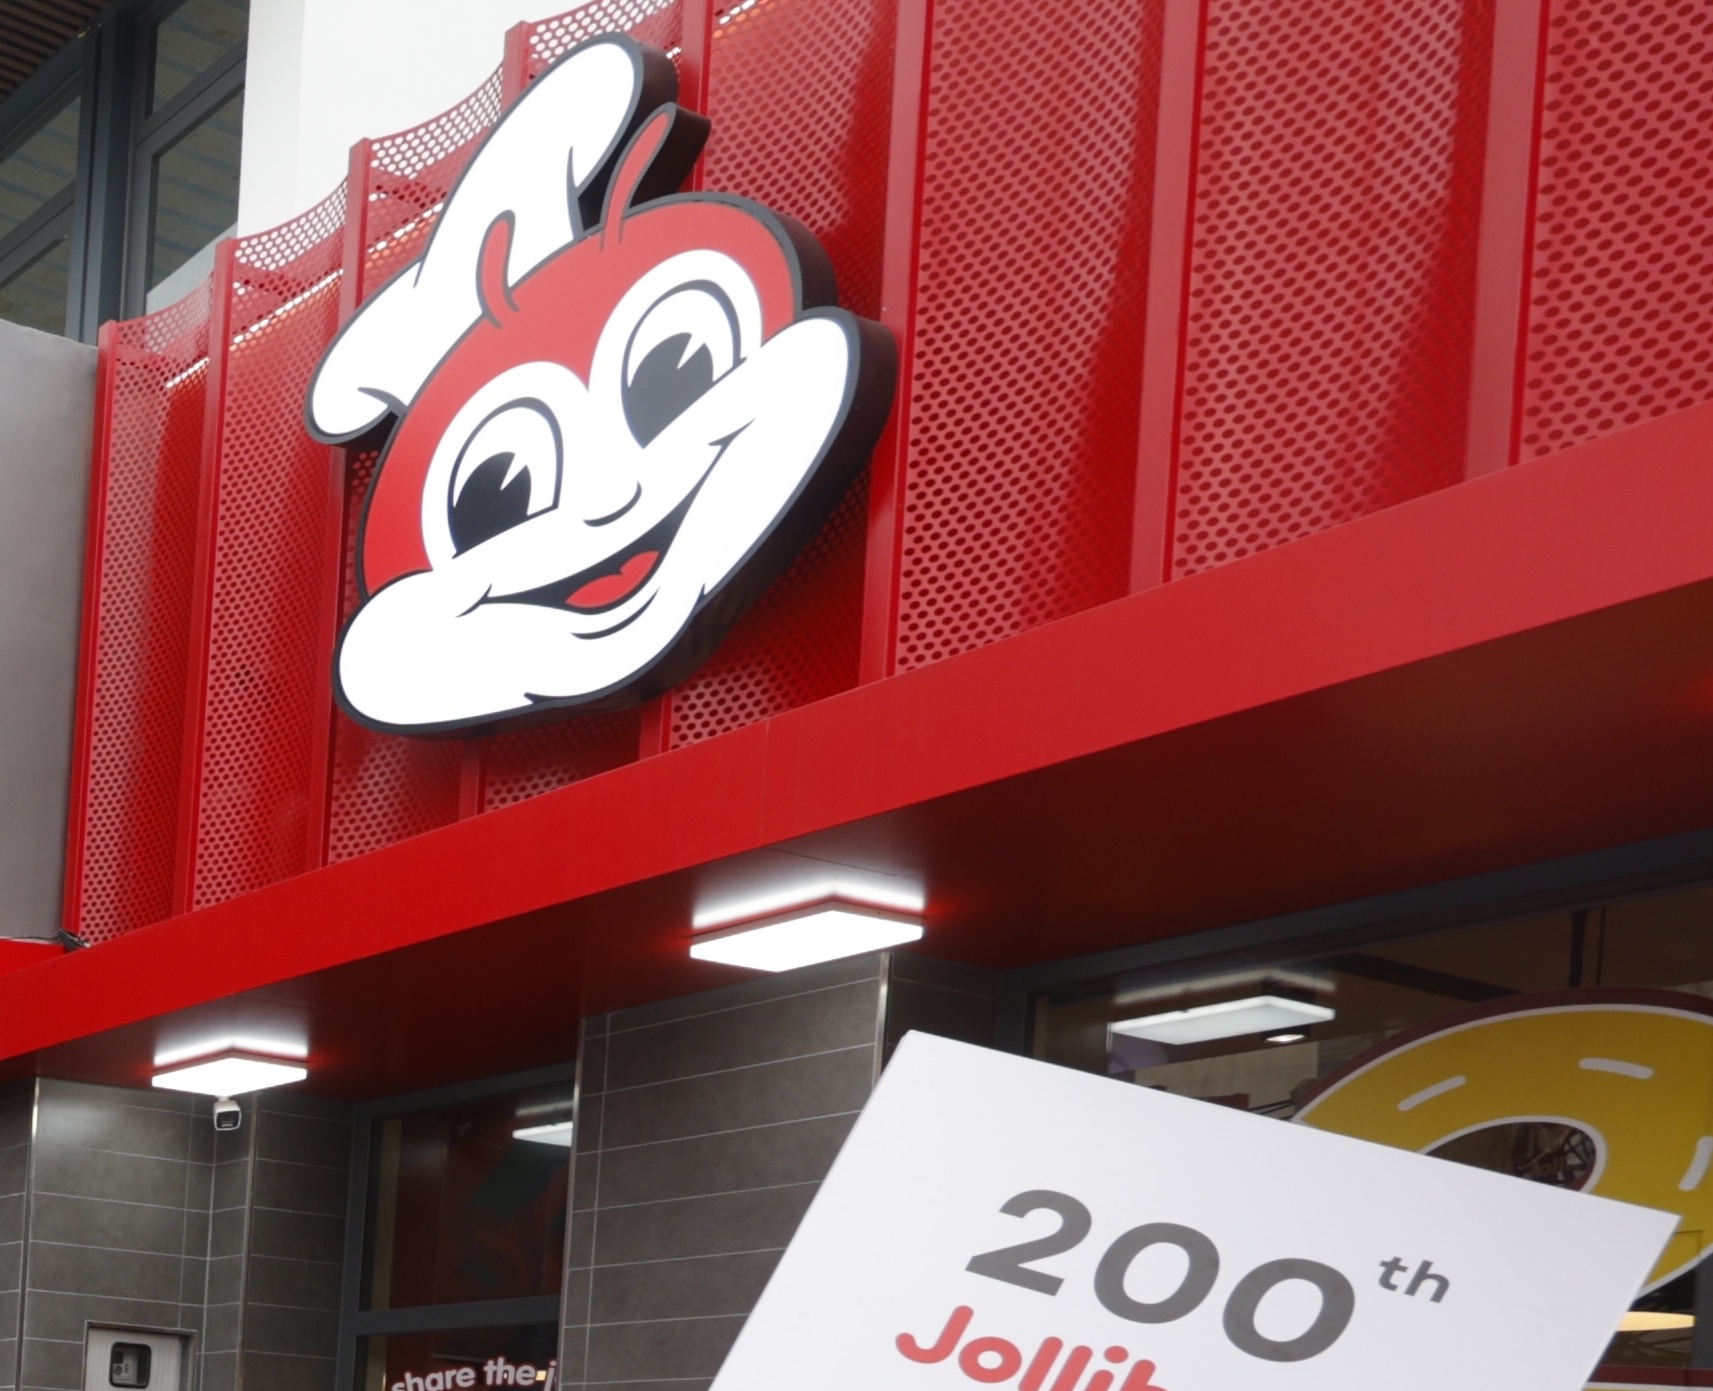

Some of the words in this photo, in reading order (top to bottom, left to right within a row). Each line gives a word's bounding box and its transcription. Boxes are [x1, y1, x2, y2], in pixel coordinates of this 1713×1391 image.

[965, 1189, 1355, 1361] 200
[1377, 1255, 1451, 1303] th
[484, 1357, 536, 1386] the
